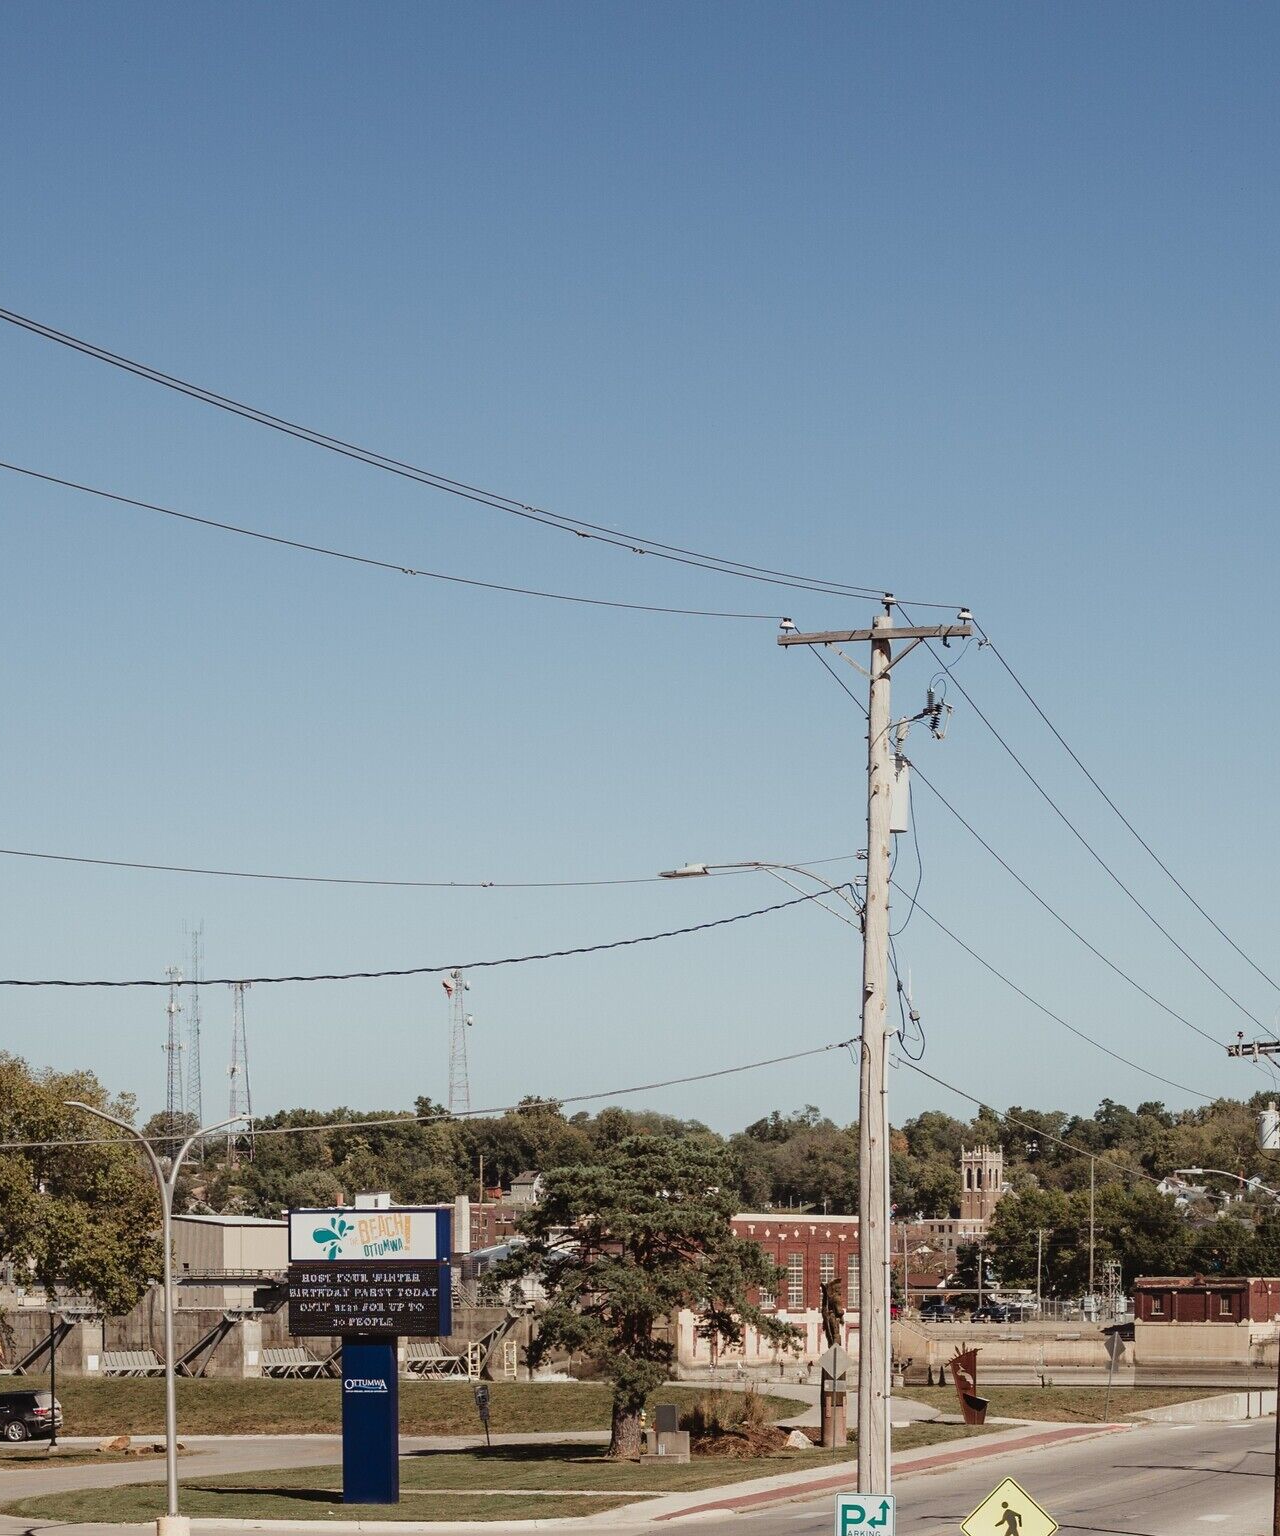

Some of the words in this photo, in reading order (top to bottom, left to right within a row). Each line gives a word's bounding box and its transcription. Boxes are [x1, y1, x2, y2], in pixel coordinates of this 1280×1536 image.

[364, 1238, 404, 1257] OTTUMWA
[301, 1273, 331, 1283] HOST
[336, 1273, 368, 1283] YOUR
[372, 1273, 421, 1283] WINTER
[289, 1288, 350, 1298] BIRTHDAY
[354, 1288, 393, 1298] PARTY
[398, 1288, 438, 1298] TODAY
[299, 1302, 331, 1312] ONLY
[361, 1303, 386, 1312] FOR
[389, 1303, 405, 1312] UP
[408, 1303, 425, 1312] TO
[348, 1317, 394, 1327] PEOPLE
[344, 1379, 388, 1390] OTTUMWA
